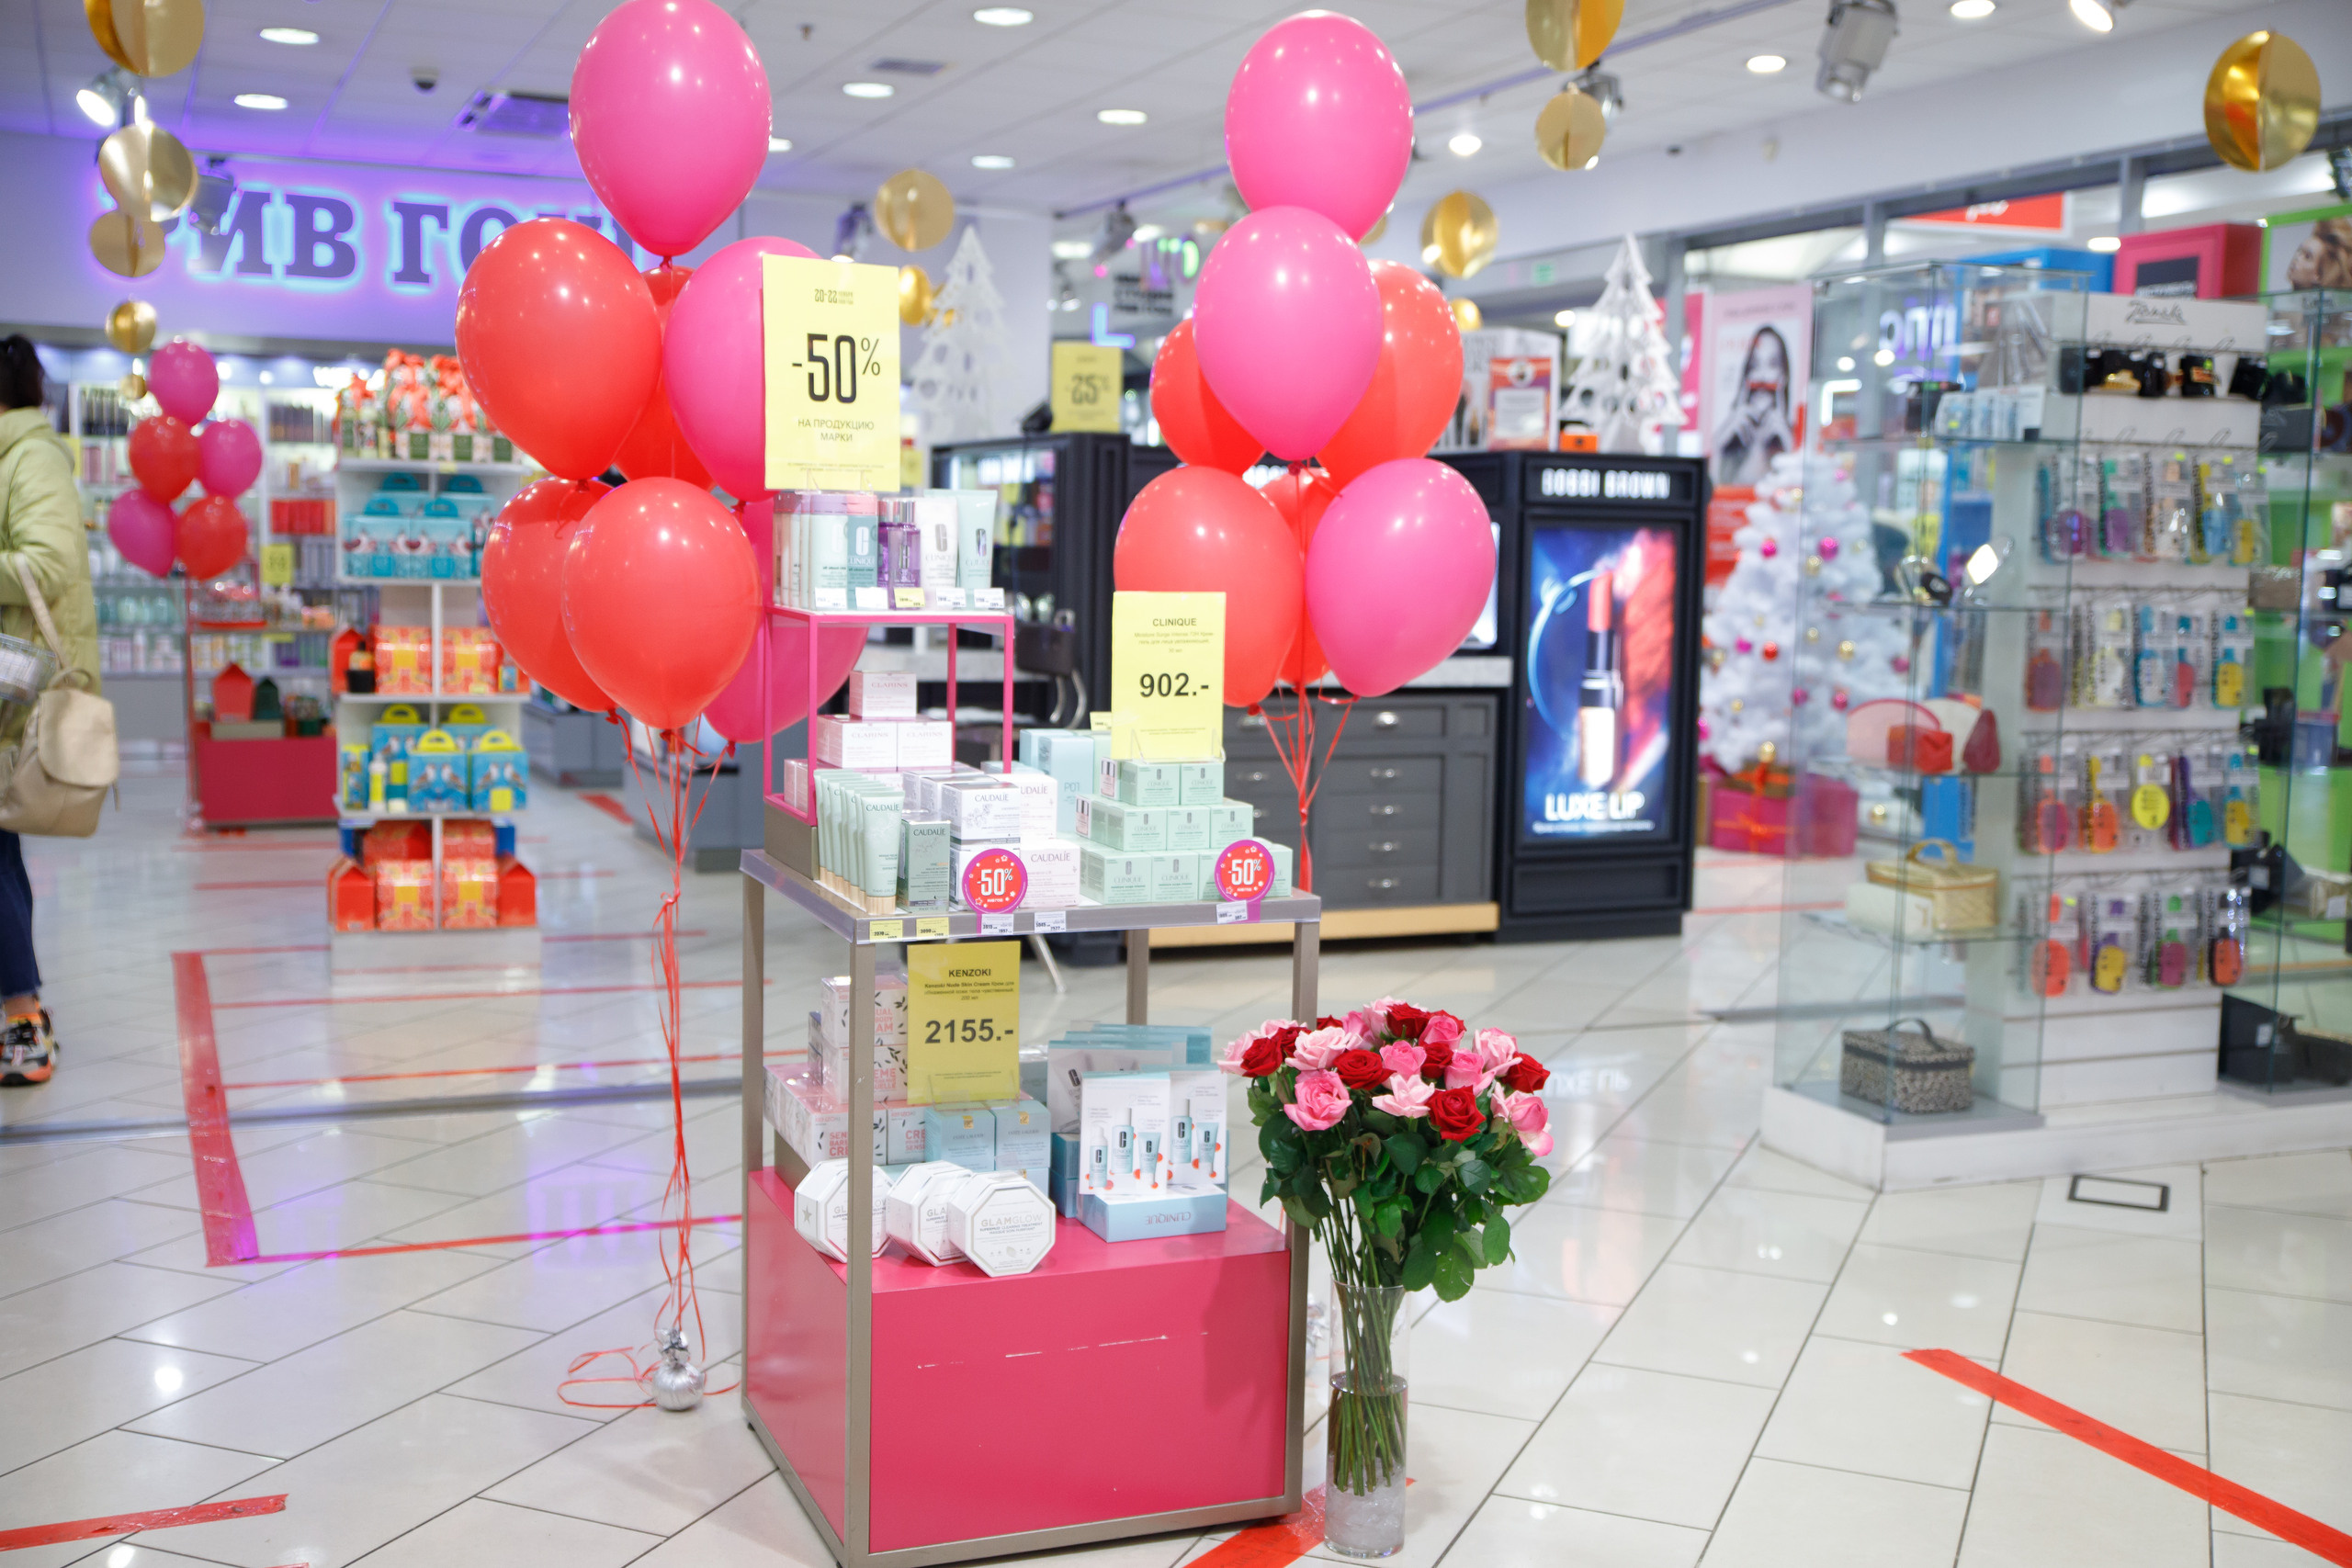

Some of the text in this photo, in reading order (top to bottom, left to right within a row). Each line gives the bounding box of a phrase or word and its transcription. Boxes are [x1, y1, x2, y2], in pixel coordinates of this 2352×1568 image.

[130, 190, 636, 284] ИВ ГО
[814, 288, 838, 304] 20-22
[792, 333, 881, 404] -50%
[797, 419, 875, 430] НА ПРОДУКЦИЮ
[820, 433, 854, 442] МАРКИ
[1542, 468, 1671, 500] BOBBI BROWN
[1152, 618, 1197, 627] CLINIQUE
[1139, 672, 1209, 698] 902.-
[1021, 785, 1047, 795] UDALÍE
[1545, 791, 1645, 821] LUXE LIP
[977, 868, 1013, 897] -50%
[1227, 859, 1261, 886] -50%
[948, 969, 991, 977] KENZOKI
[924, 1019, 1013, 1044] 2155.-
[980, 1213, 1042, 1227] GLAMGLOW
